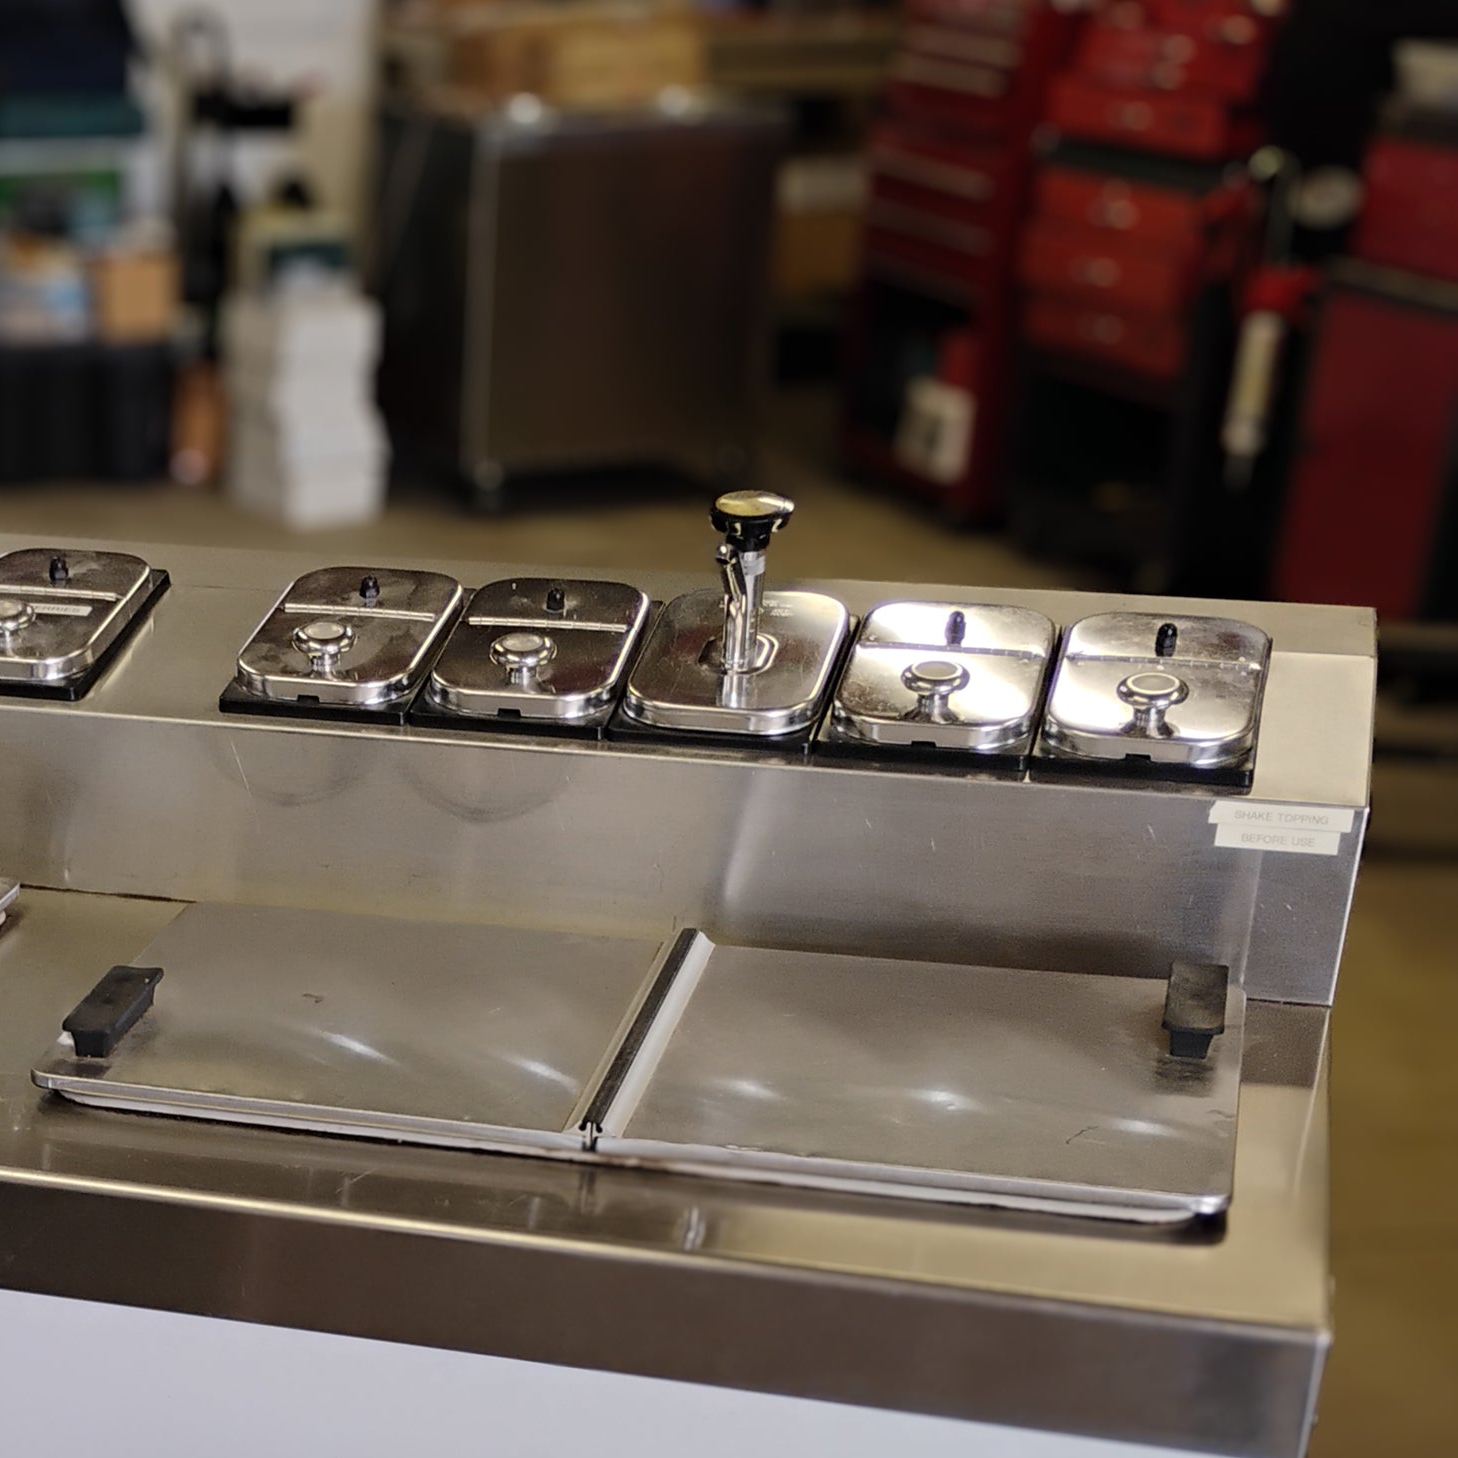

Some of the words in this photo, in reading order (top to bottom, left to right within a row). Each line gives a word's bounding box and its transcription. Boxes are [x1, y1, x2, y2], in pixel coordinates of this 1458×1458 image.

[1233, 809, 1273, 821] SHAKE
[1277, 812, 1329, 825] TOPPING
[1241, 832, 1287, 847] BEFORE
[1292, 836, 1316, 848] USE
